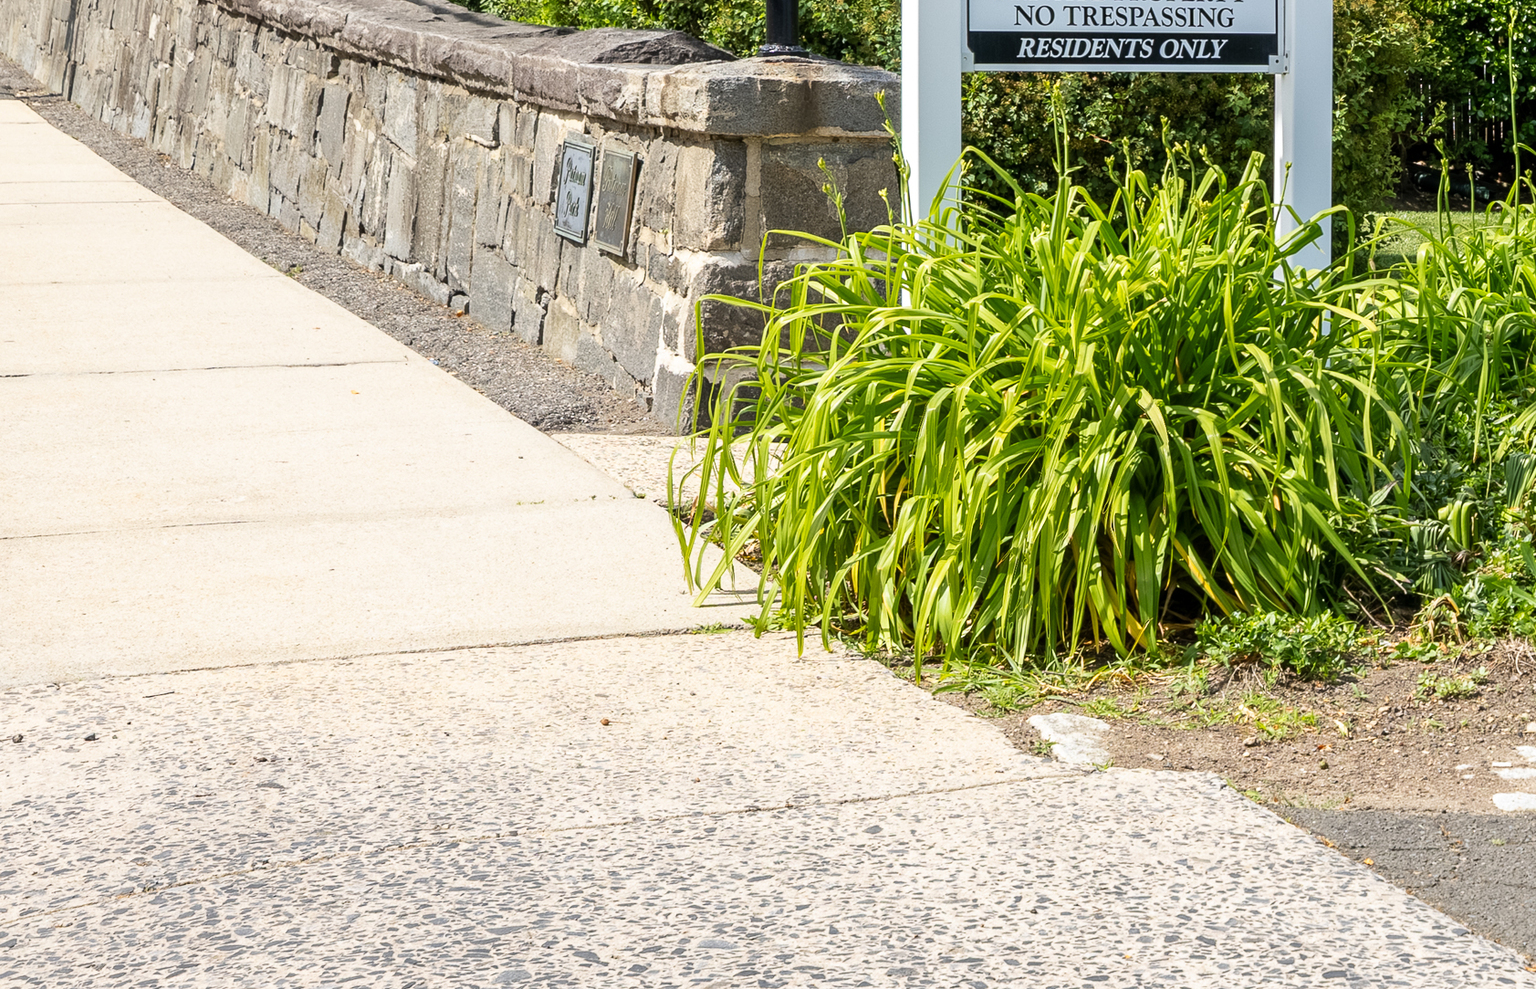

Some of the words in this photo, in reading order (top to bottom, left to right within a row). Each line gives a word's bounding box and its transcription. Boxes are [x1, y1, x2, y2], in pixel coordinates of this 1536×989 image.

[1014, 4, 1055, 26] NO
[1063, 5, 1235, 28] TRESPASSING
[1016, 37, 1154, 59] RESIDENTS
[1159, 38, 1228, 60] ONLY
